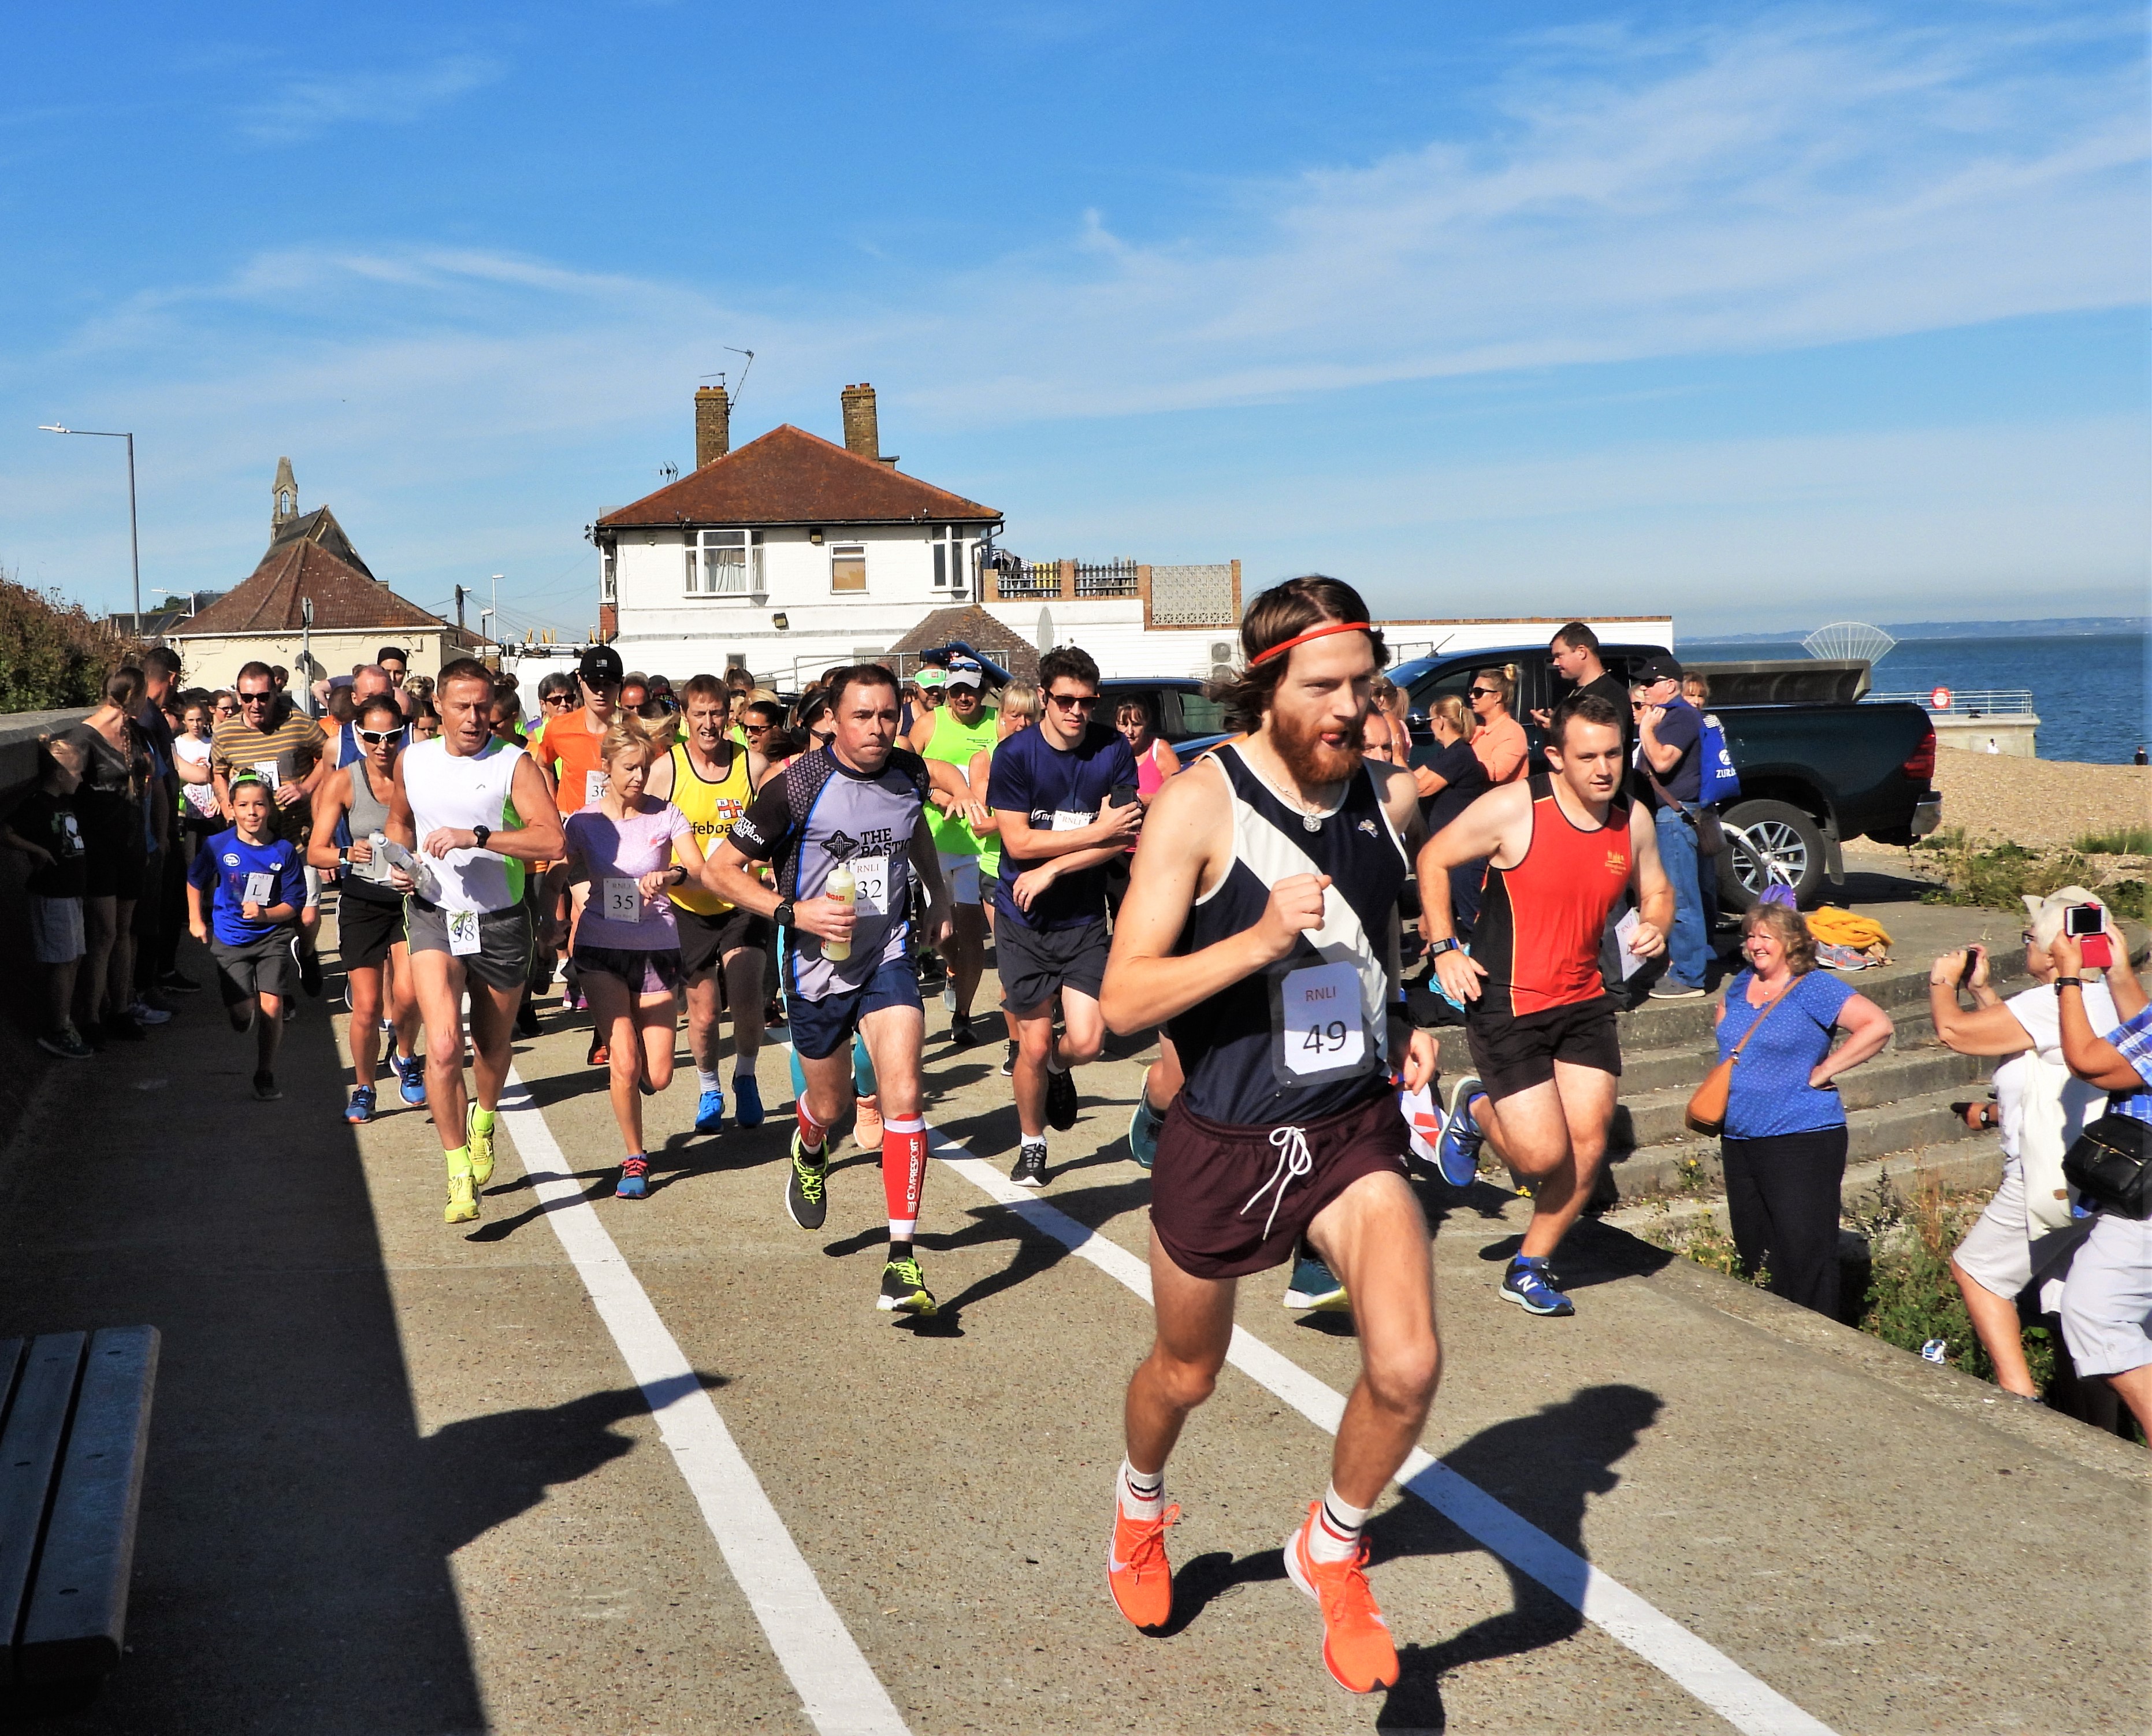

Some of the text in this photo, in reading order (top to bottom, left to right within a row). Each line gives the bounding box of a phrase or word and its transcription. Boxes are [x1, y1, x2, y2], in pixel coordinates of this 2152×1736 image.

[692, 821, 733, 835] feboa
[740, 817, 757, 832] STLE
[1062, 816, 1081, 826] RNLI
[861, 828, 892, 845] THE
[857, 864, 879, 873] RNLI
[857, 879, 882, 899] 32
[613, 895, 633, 909] 35
[1306, 986, 1336, 1002] RNLI
[1303, 1021, 1347, 1054] 49
